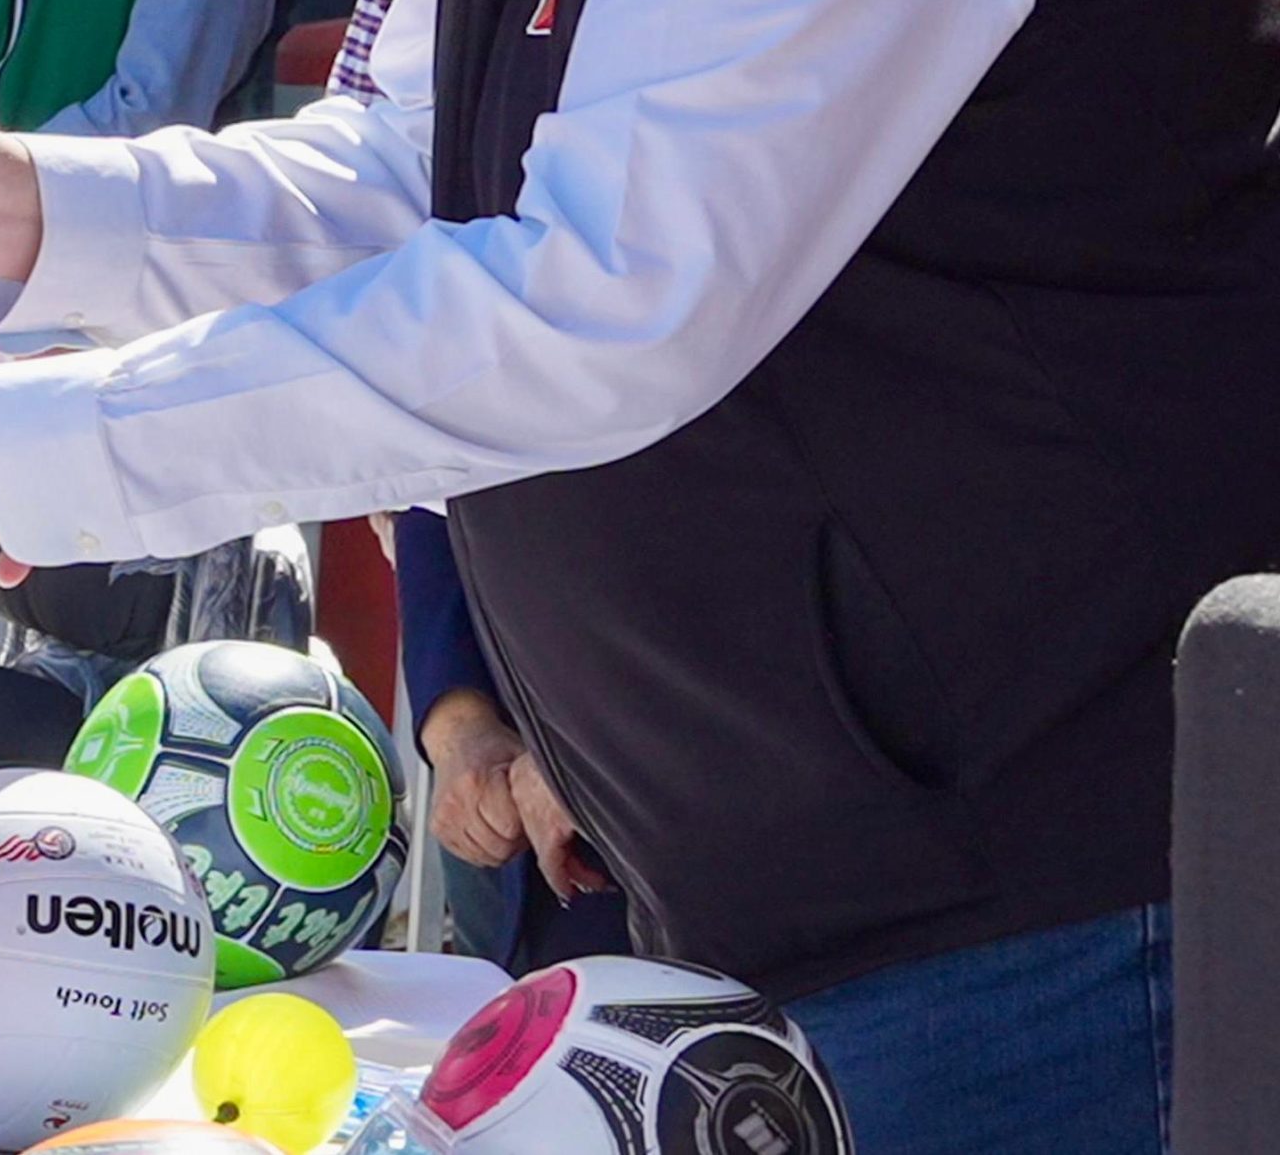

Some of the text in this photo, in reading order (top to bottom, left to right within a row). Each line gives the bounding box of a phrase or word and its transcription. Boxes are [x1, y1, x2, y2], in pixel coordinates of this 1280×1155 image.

[27, 894, 200, 958] molten
[56, 987, 169, 1022] Soft Touch
